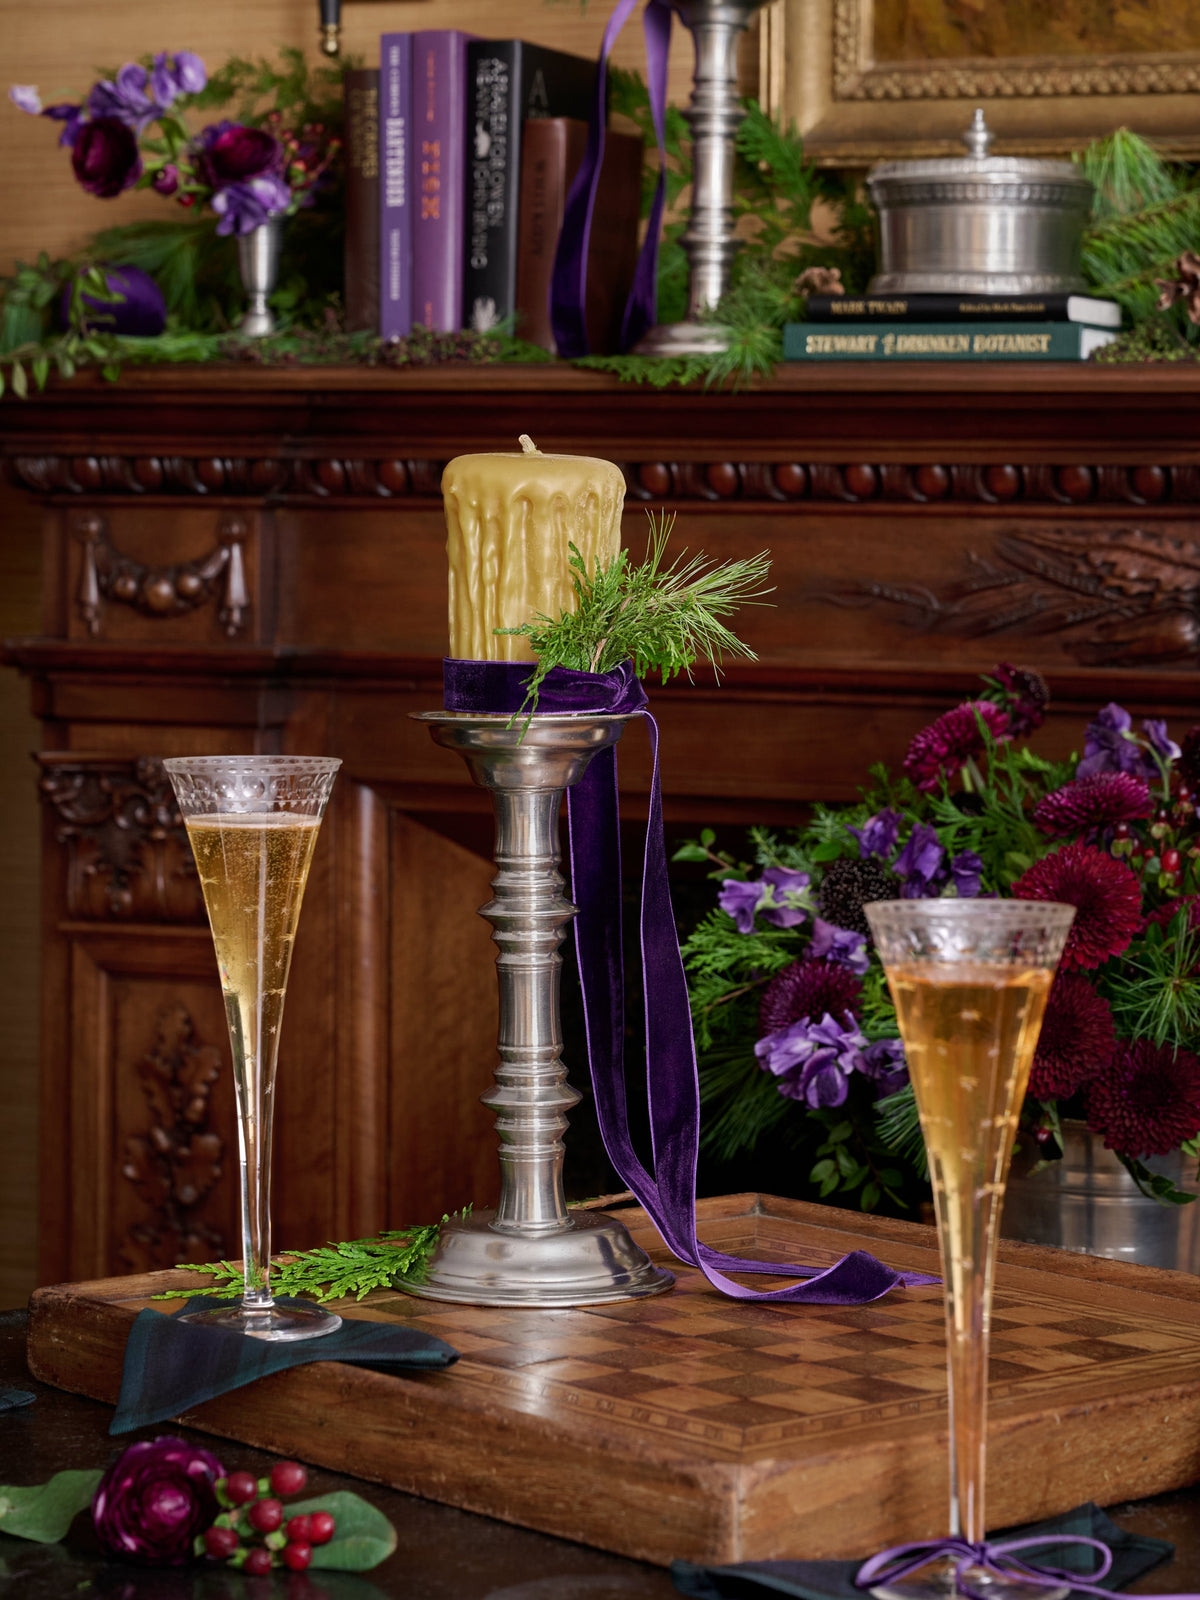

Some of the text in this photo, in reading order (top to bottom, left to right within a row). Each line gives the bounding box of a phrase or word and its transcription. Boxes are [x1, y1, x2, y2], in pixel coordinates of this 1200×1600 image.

[475, 59, 491, 120] MEANY
[490, 75, 508, 134] PRAYER
[386, 118, 404, 207] BARTENDER
[489, 135, 506, 170] FOR
[471, 160, 490, 270] JOHN IRVING
[487, 170, 505, 227] OWEN
[831, 300, 908, 315] MARK TWAIN
[806, 335, 878, 353] STEWART
[896, 335, 970, 353] DRUNKEN
[973, 334, 1051, 353] BOTANIST
